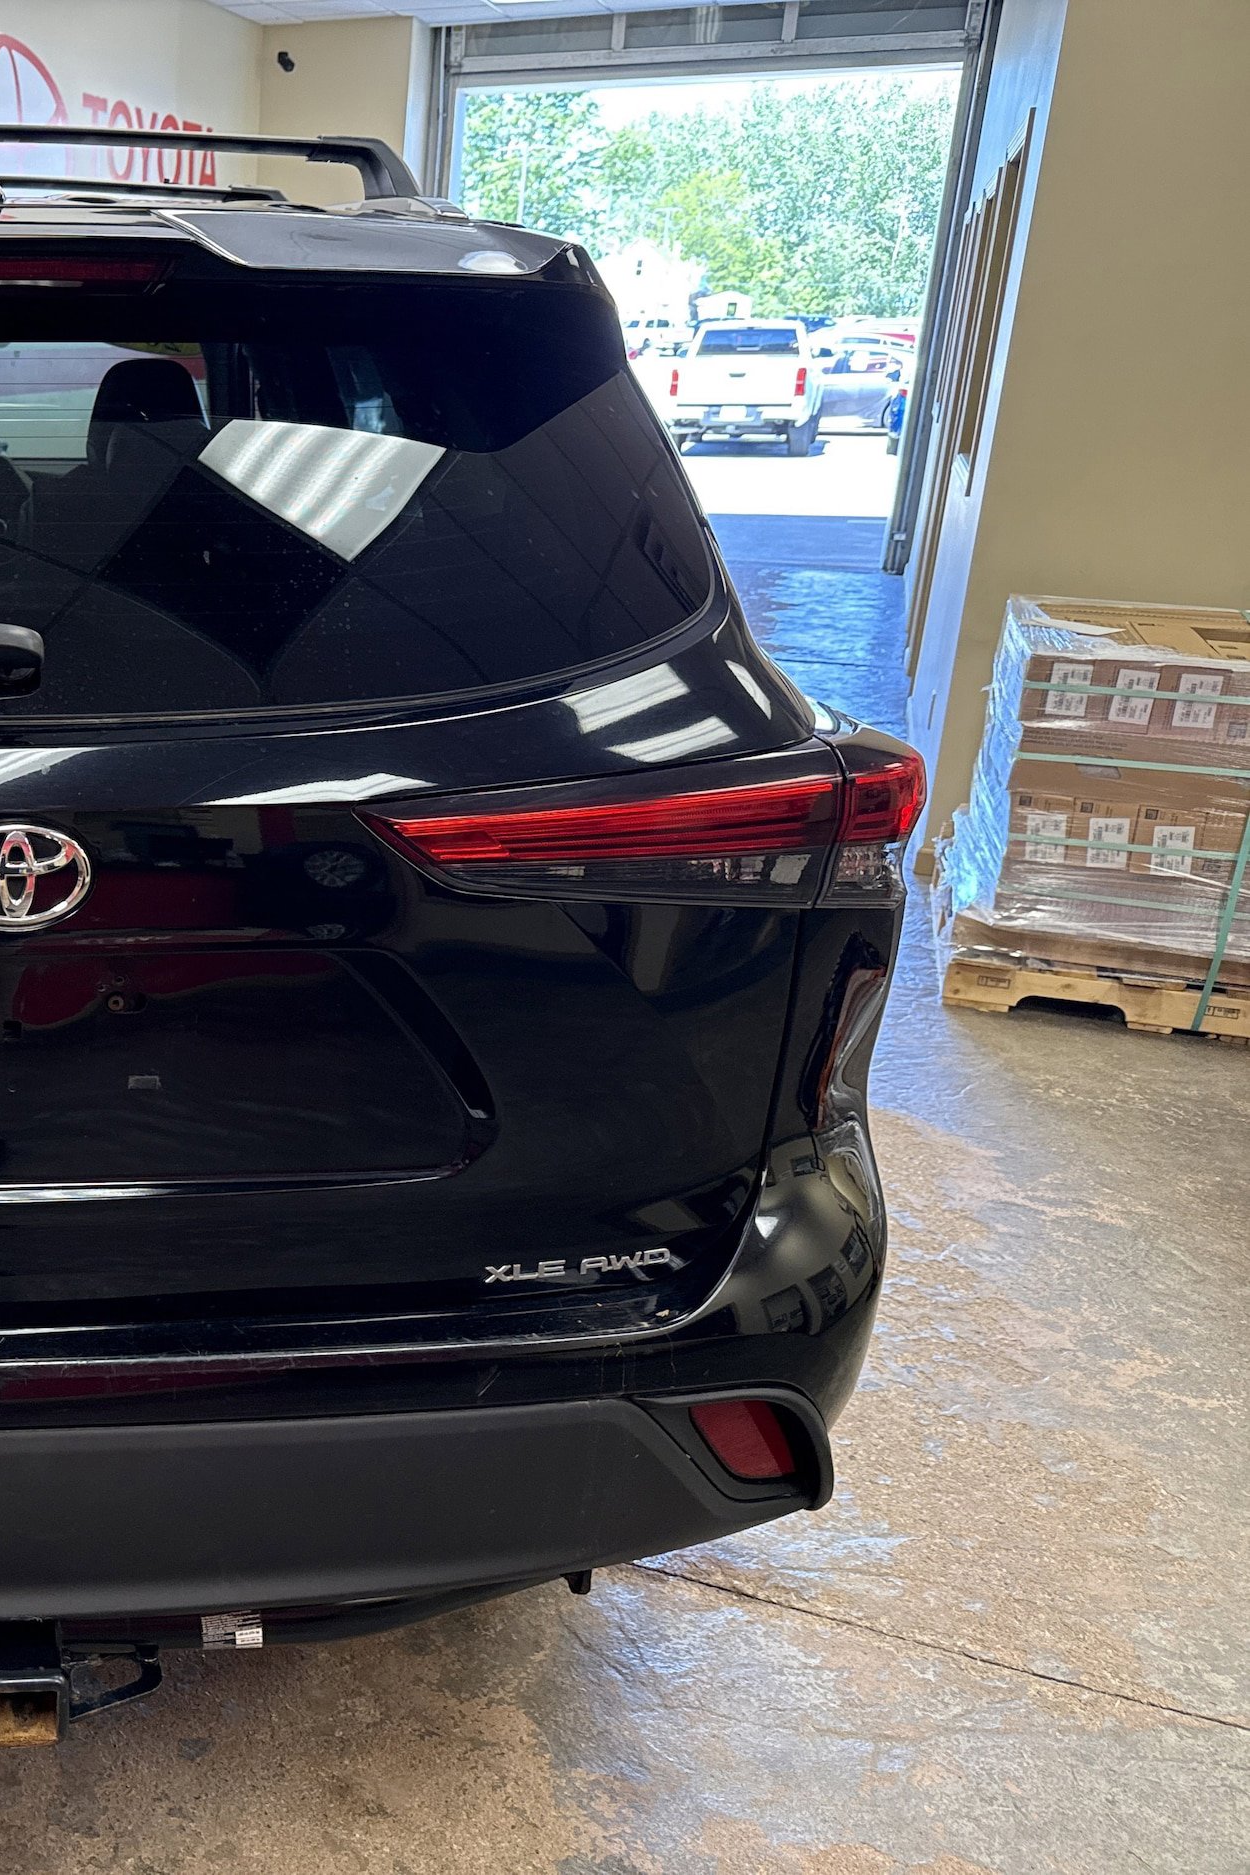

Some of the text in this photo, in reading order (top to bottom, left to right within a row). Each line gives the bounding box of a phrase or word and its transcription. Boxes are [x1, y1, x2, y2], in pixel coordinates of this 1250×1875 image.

[82, 92, 216, 186] TOYOTA
[484, 1248, 671, 1284] XLE AWD
